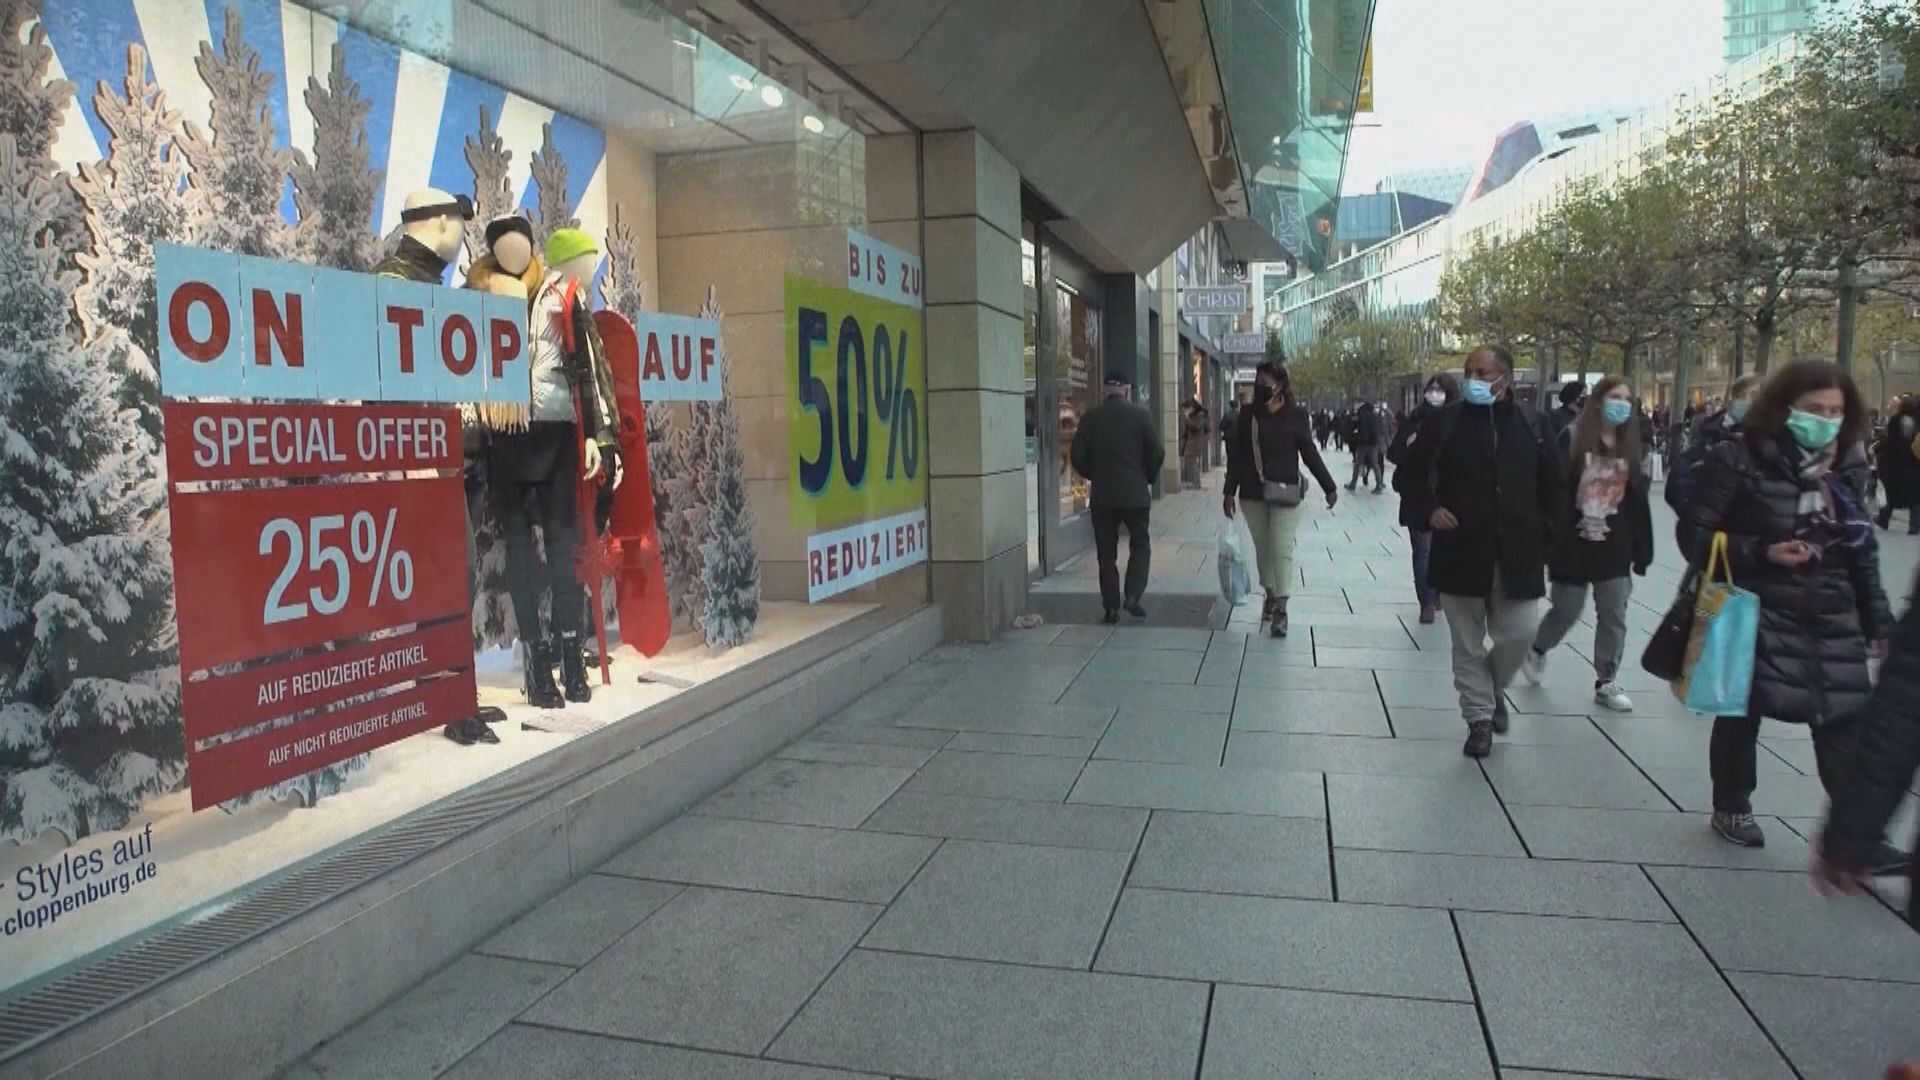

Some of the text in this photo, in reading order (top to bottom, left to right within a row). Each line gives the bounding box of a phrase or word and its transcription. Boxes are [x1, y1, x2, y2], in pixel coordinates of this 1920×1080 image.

[849, 242, 920, 296] BIS ZU
[1186, 291, 1242, 310] CHRIST
[168, 280, 522, 379] ON TOP
[642, 331, 716, 382] AUF
[798, 306, 919, 494] 50%
[192, 415, 449, 468] SPECIAL OFFER
[258, 507, 414, 625] 25%
[808, 519, 926, 588] REDUZIERT
[257, 644, 428, 706] AUF REDUZIERTE ARTIKEL
[268, 701, 428, 767] AUF NICHT REDUZIERTE ARTIKEL
[15, 822, 153, 902] Styles auf
